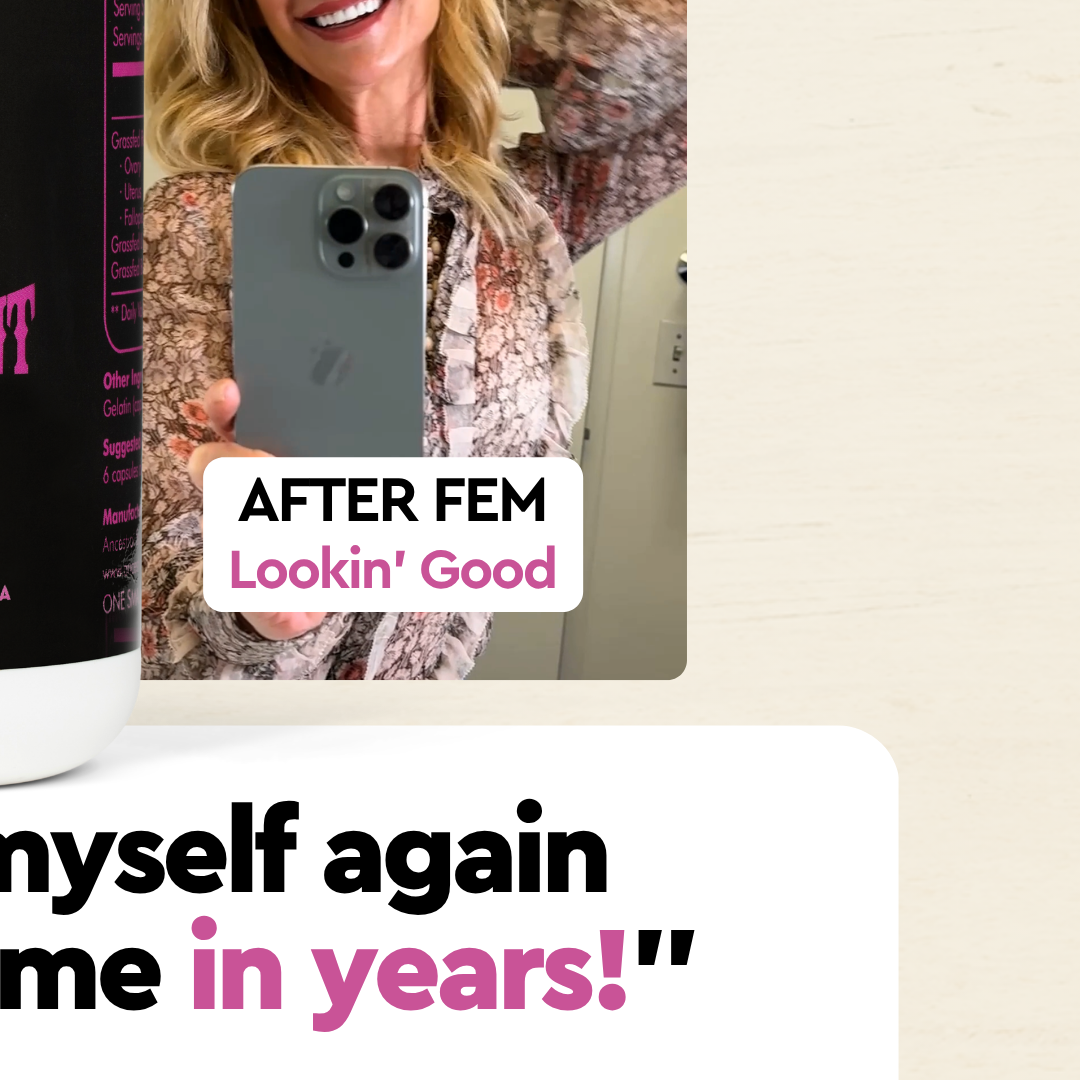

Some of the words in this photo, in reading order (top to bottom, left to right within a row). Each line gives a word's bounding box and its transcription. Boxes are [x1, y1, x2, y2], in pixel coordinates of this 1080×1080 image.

[111, 129, 140, 150] Grassfed
[124, 157, 141, 177] Ovary
[124, 182, 142, 201] Uterus
[111, 233, 140, 253] Grassfed
[111, 259, 140, 279] Grassfed
[103, 370, 130, 390] Other
[103, 397, 131, 417] Gelatin
[103, 432, 142, 459] Suggested
[103, 465, 109, 484] 6
[112, 461, 139, 485] capsules
[102, 590, 126, 614] ONE
